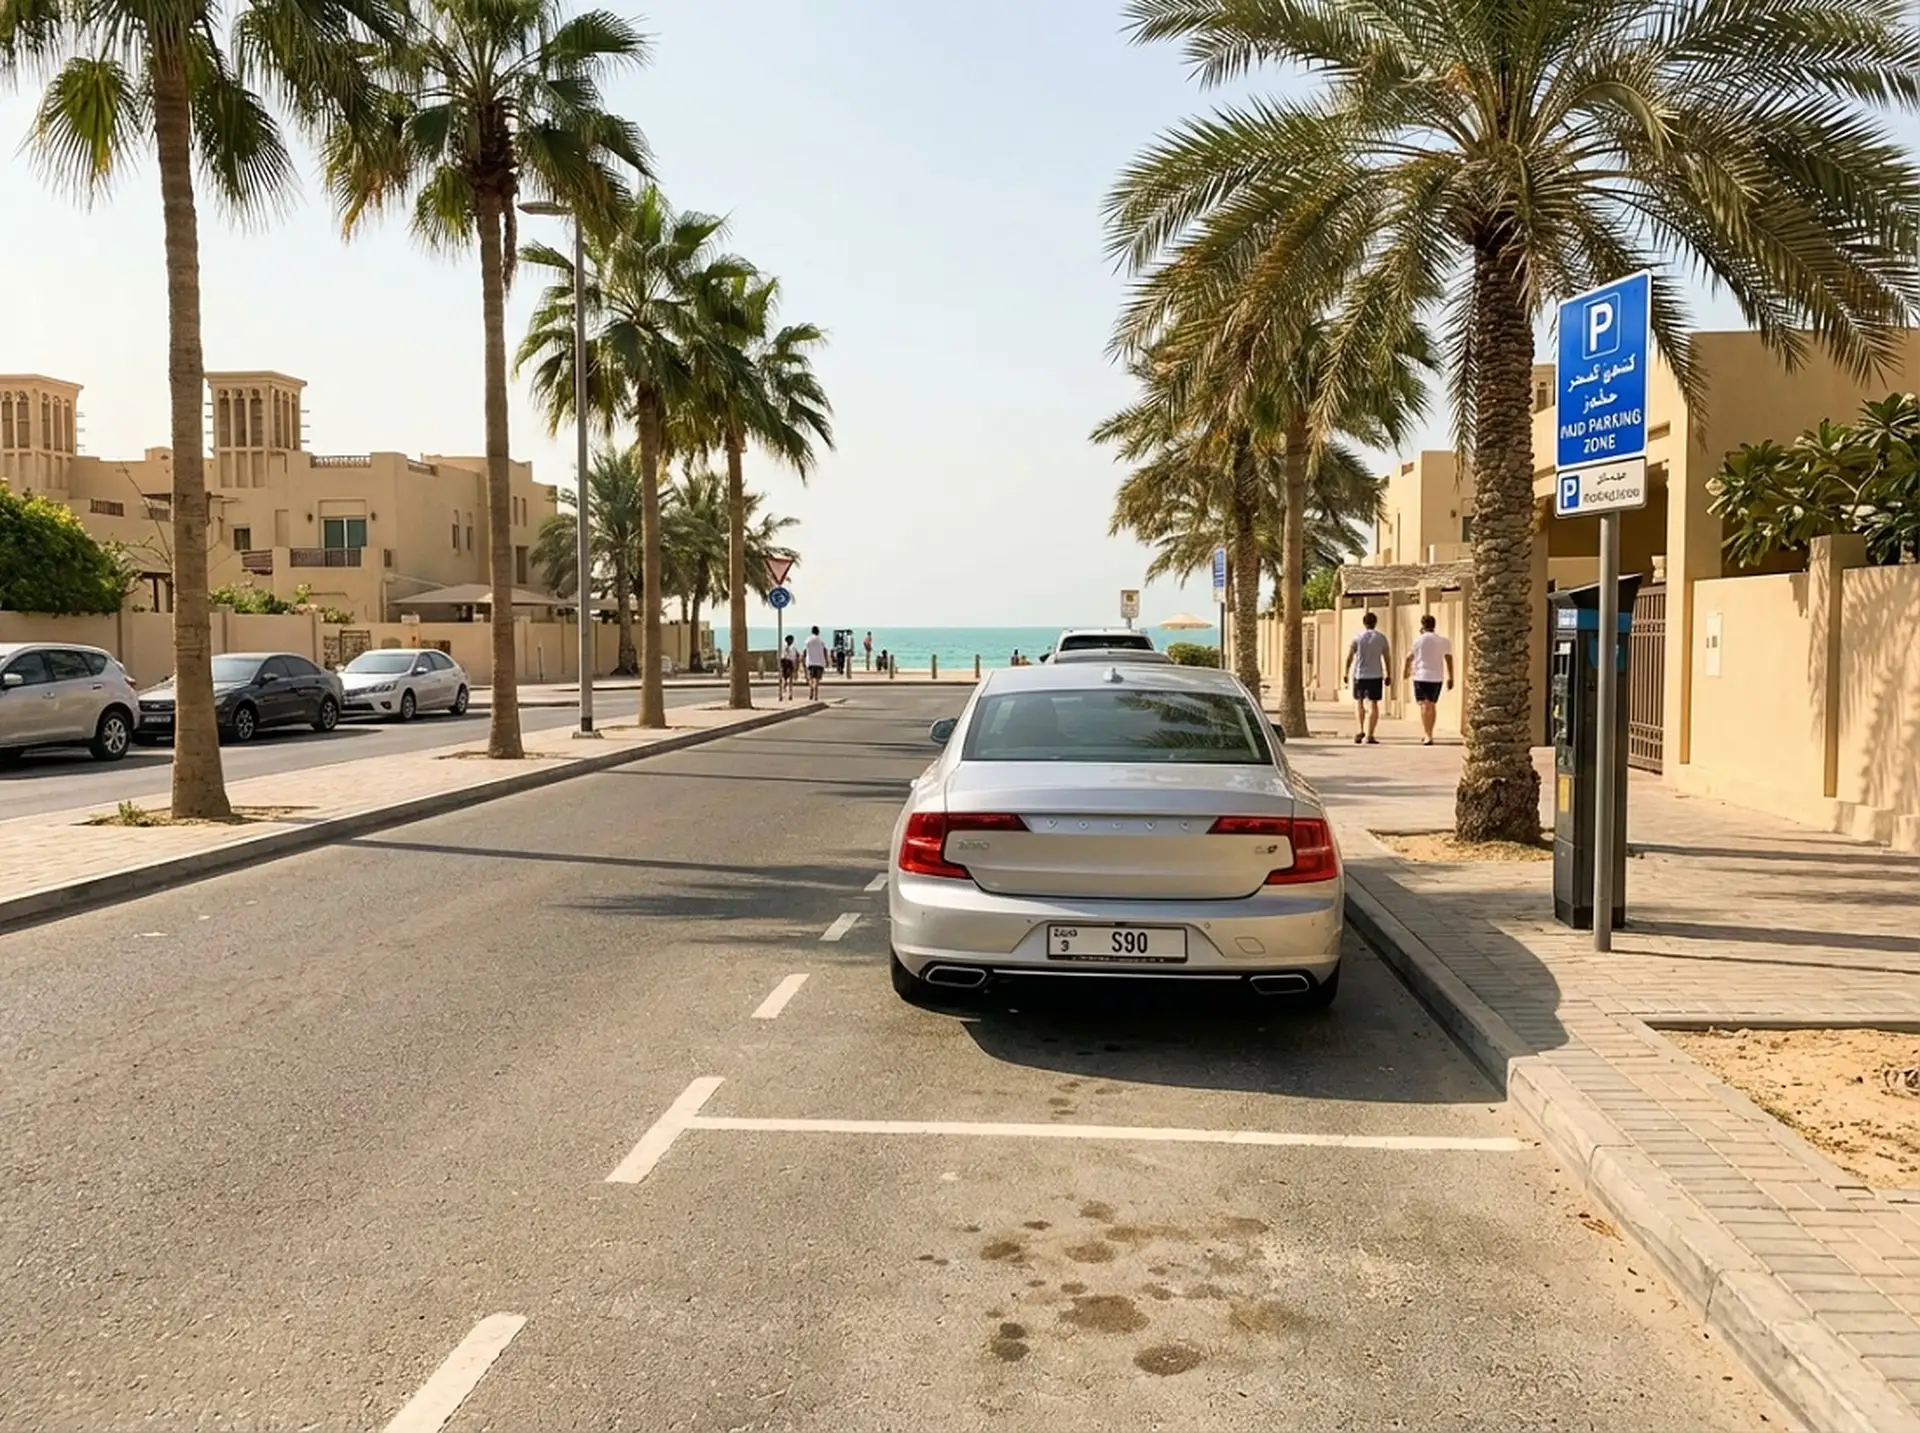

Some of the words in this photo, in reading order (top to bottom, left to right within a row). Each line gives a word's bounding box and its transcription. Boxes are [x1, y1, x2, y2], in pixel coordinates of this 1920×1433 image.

[1590, 302, 1613, 351] P
[1589, 408, 1642, 433] PARKING
[1583, 434, 1616, 454] ZONE
[1563, 479, 1577, 508] P
[1111, 931, 1148, 954] S90
